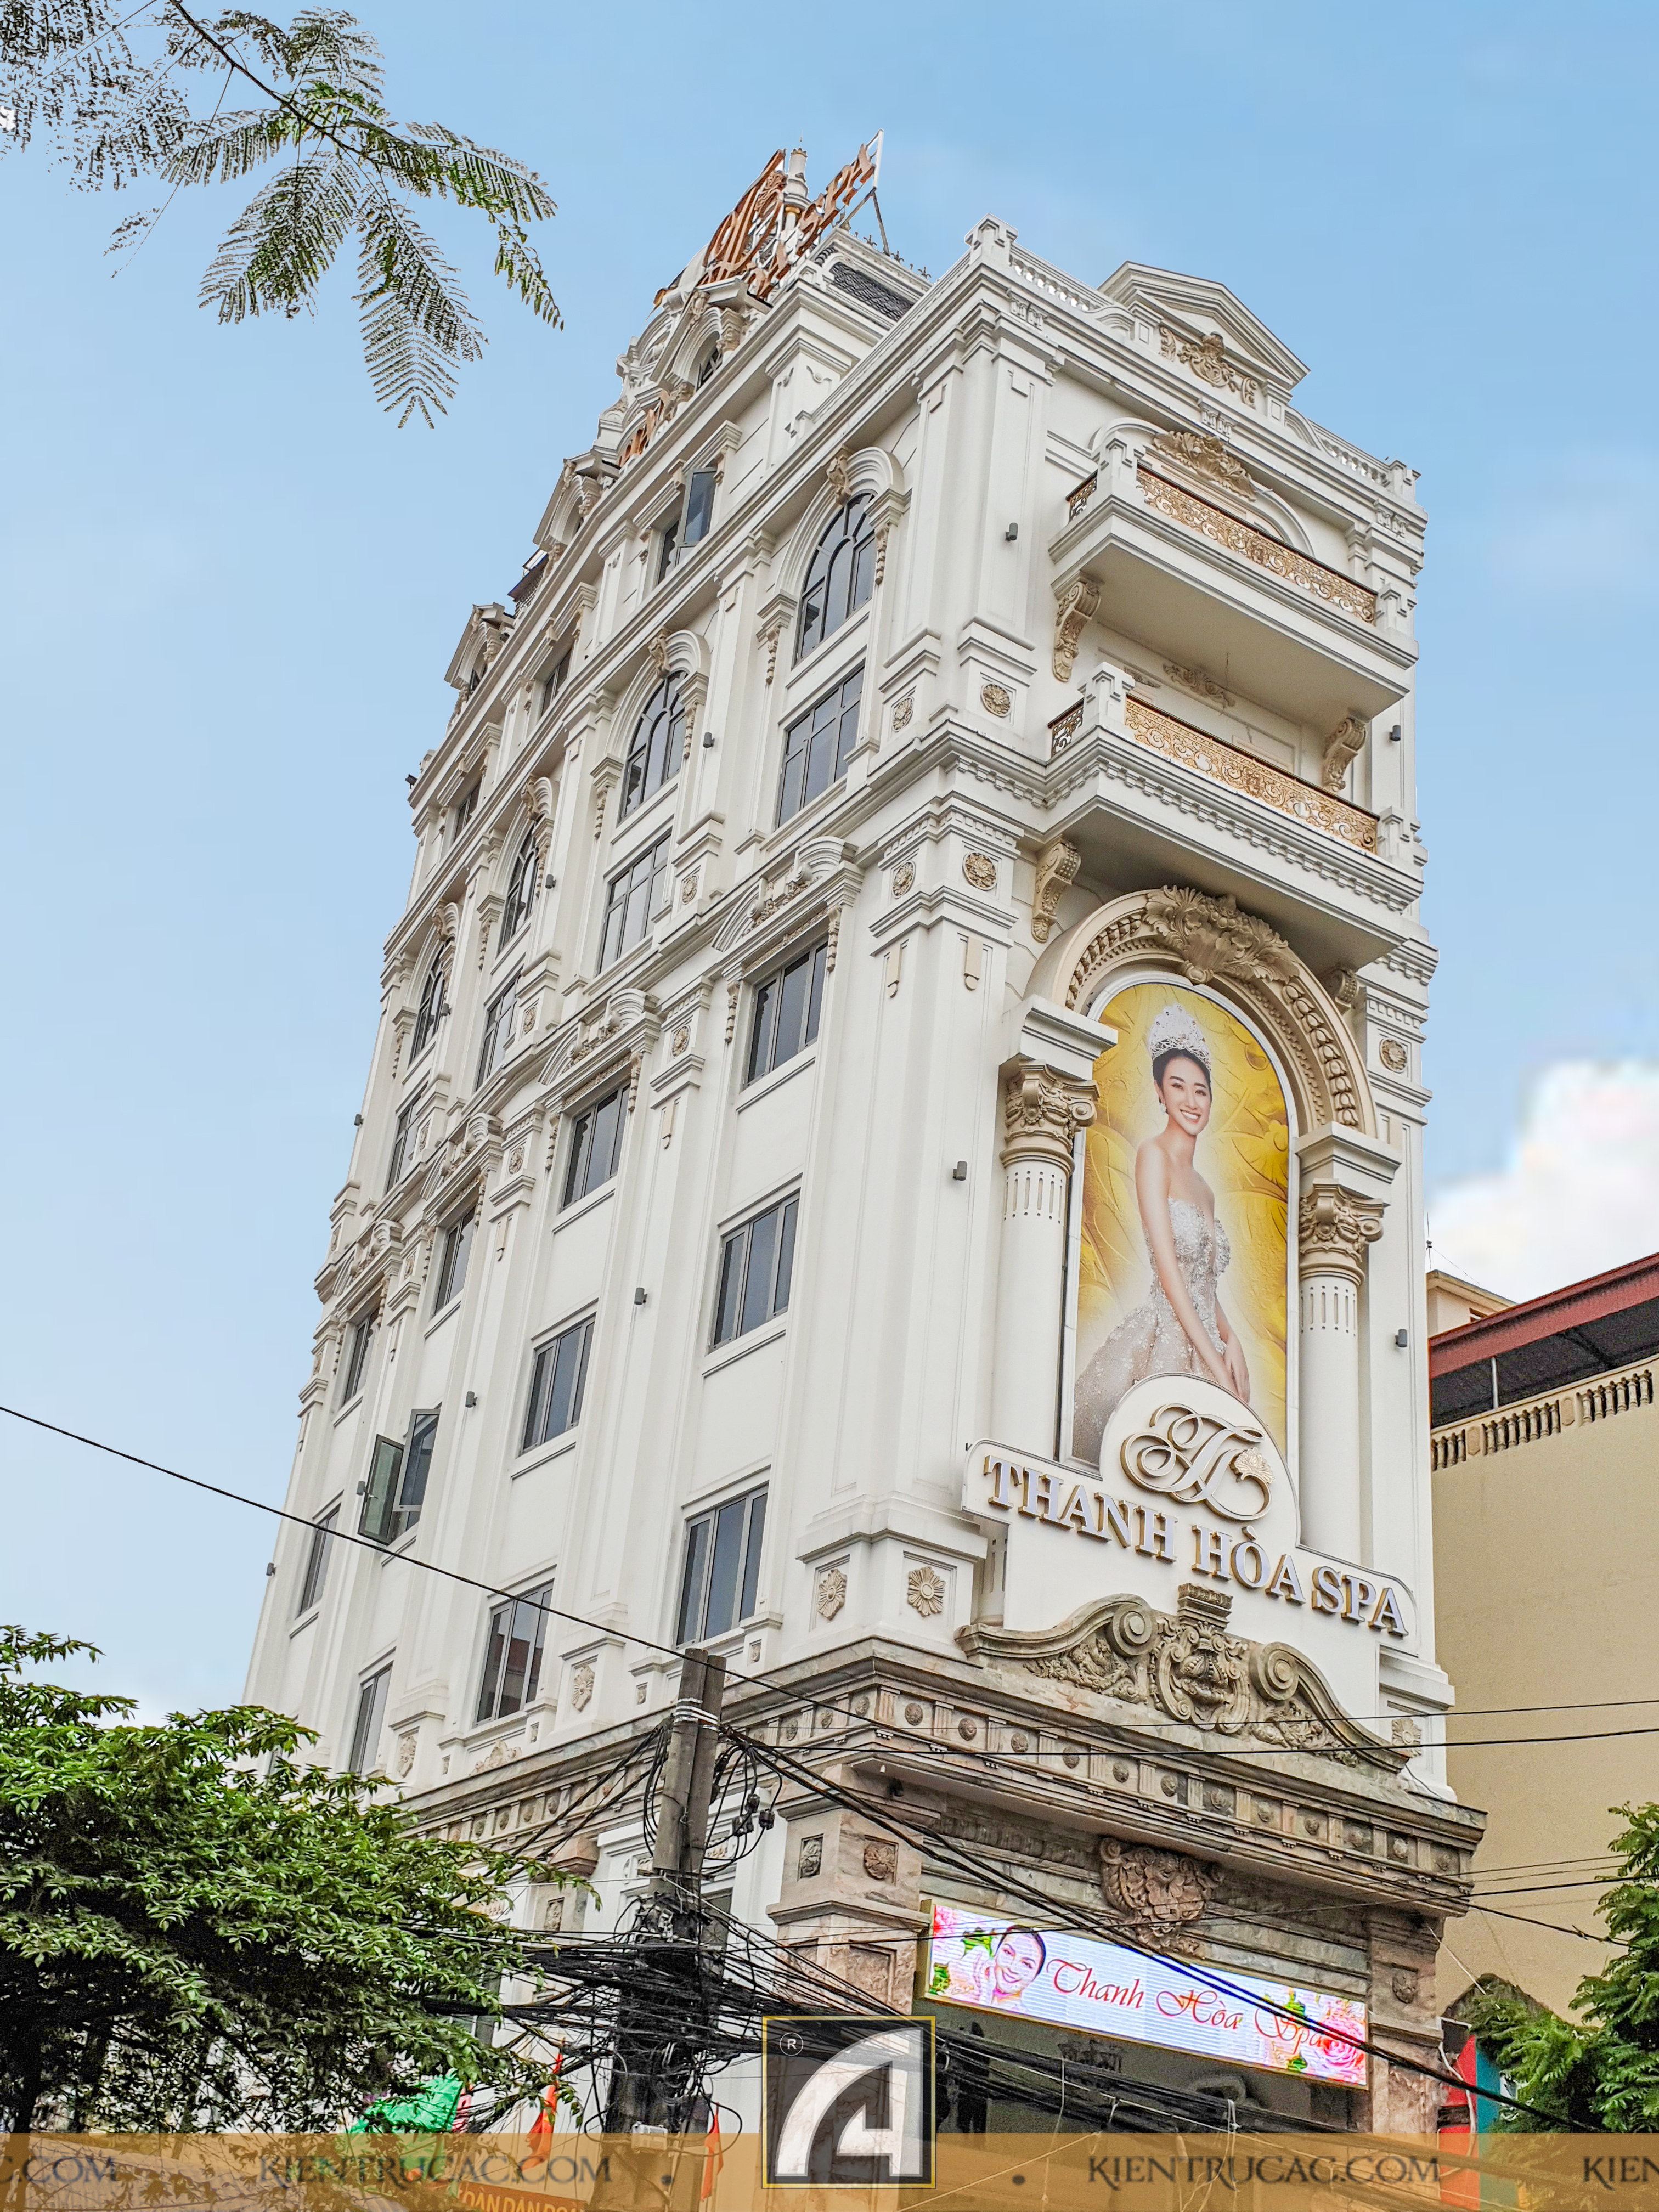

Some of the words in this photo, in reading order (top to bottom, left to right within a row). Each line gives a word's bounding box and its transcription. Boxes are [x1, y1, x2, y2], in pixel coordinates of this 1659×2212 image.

[984, 1455, 1179, 1562] THANH
[1190, 1525, 1307, 1606] HÒA
[1311, 1566, 1409, 1638] SPA
[1046, 1959, 1145, 2009] Thanh
[1156, 1989, 1244, 2030] Hòa
